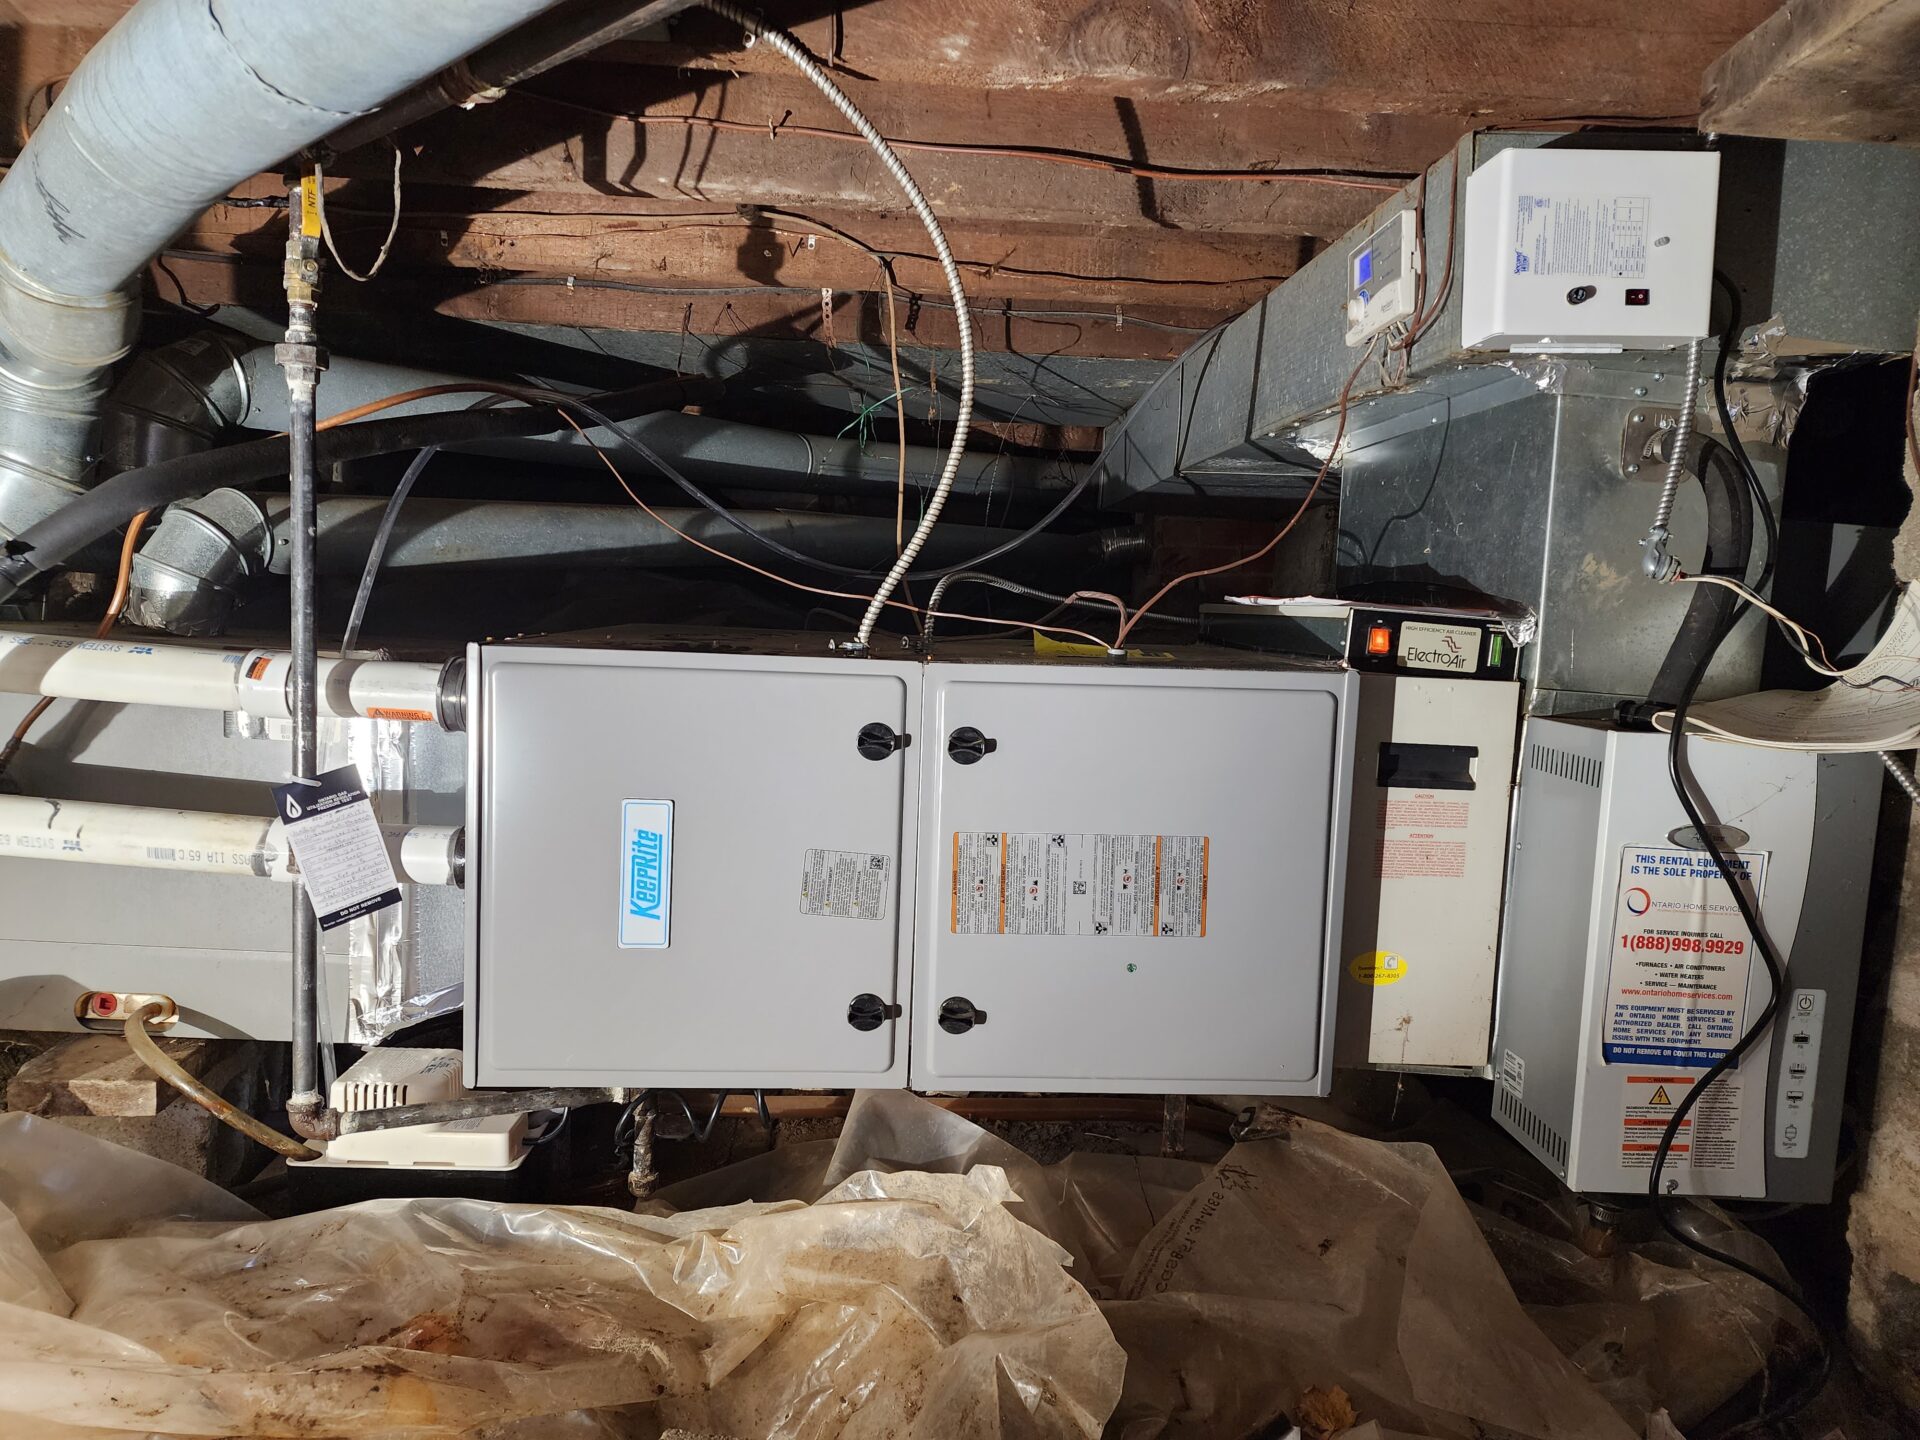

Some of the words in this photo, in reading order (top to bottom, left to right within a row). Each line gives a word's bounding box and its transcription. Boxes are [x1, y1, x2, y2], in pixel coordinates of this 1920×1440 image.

[1407, 647, 1467, 668] ElectroAir
[1636, 854, 1656, 864] THIS
[1659, 856, 1693, 866] RENTAL
[629, 829, 663, 920] KeepRite
[1631, 866, 1640, 874] IS
[1643, 866, 1660, 875] THE
[1663, 868, 1687, 877] SOLE
[1740, 872, 1752, 880] OF
[1683, 902, 1707, 910] HOME
[1621, 935, 1744, 954] 1(888)998.9929
[1621, 988, 1733, 1000] www.ontariohomeservices.com
[1636, 1028, 1666, 1036] SERVICES
